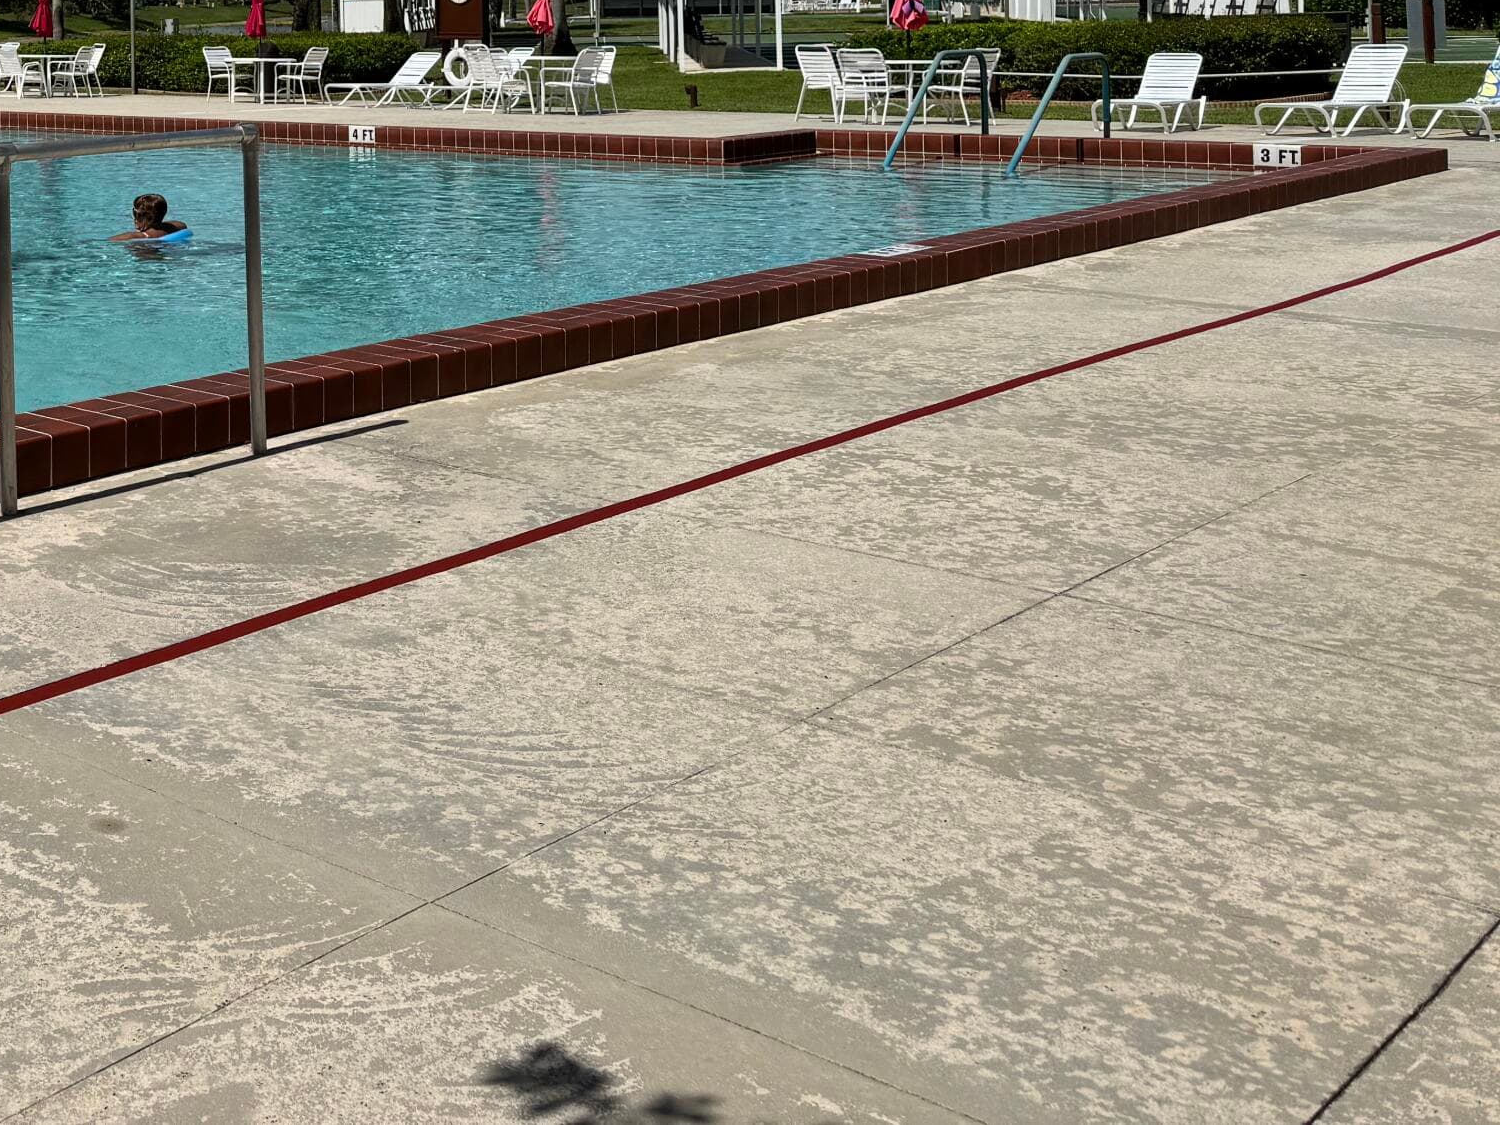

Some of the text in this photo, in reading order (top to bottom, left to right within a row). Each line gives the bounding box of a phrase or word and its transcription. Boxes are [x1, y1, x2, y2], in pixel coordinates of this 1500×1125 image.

[352, 128, 358, 141] 4
[1260, 148, 1299, 165] 3 FT.
